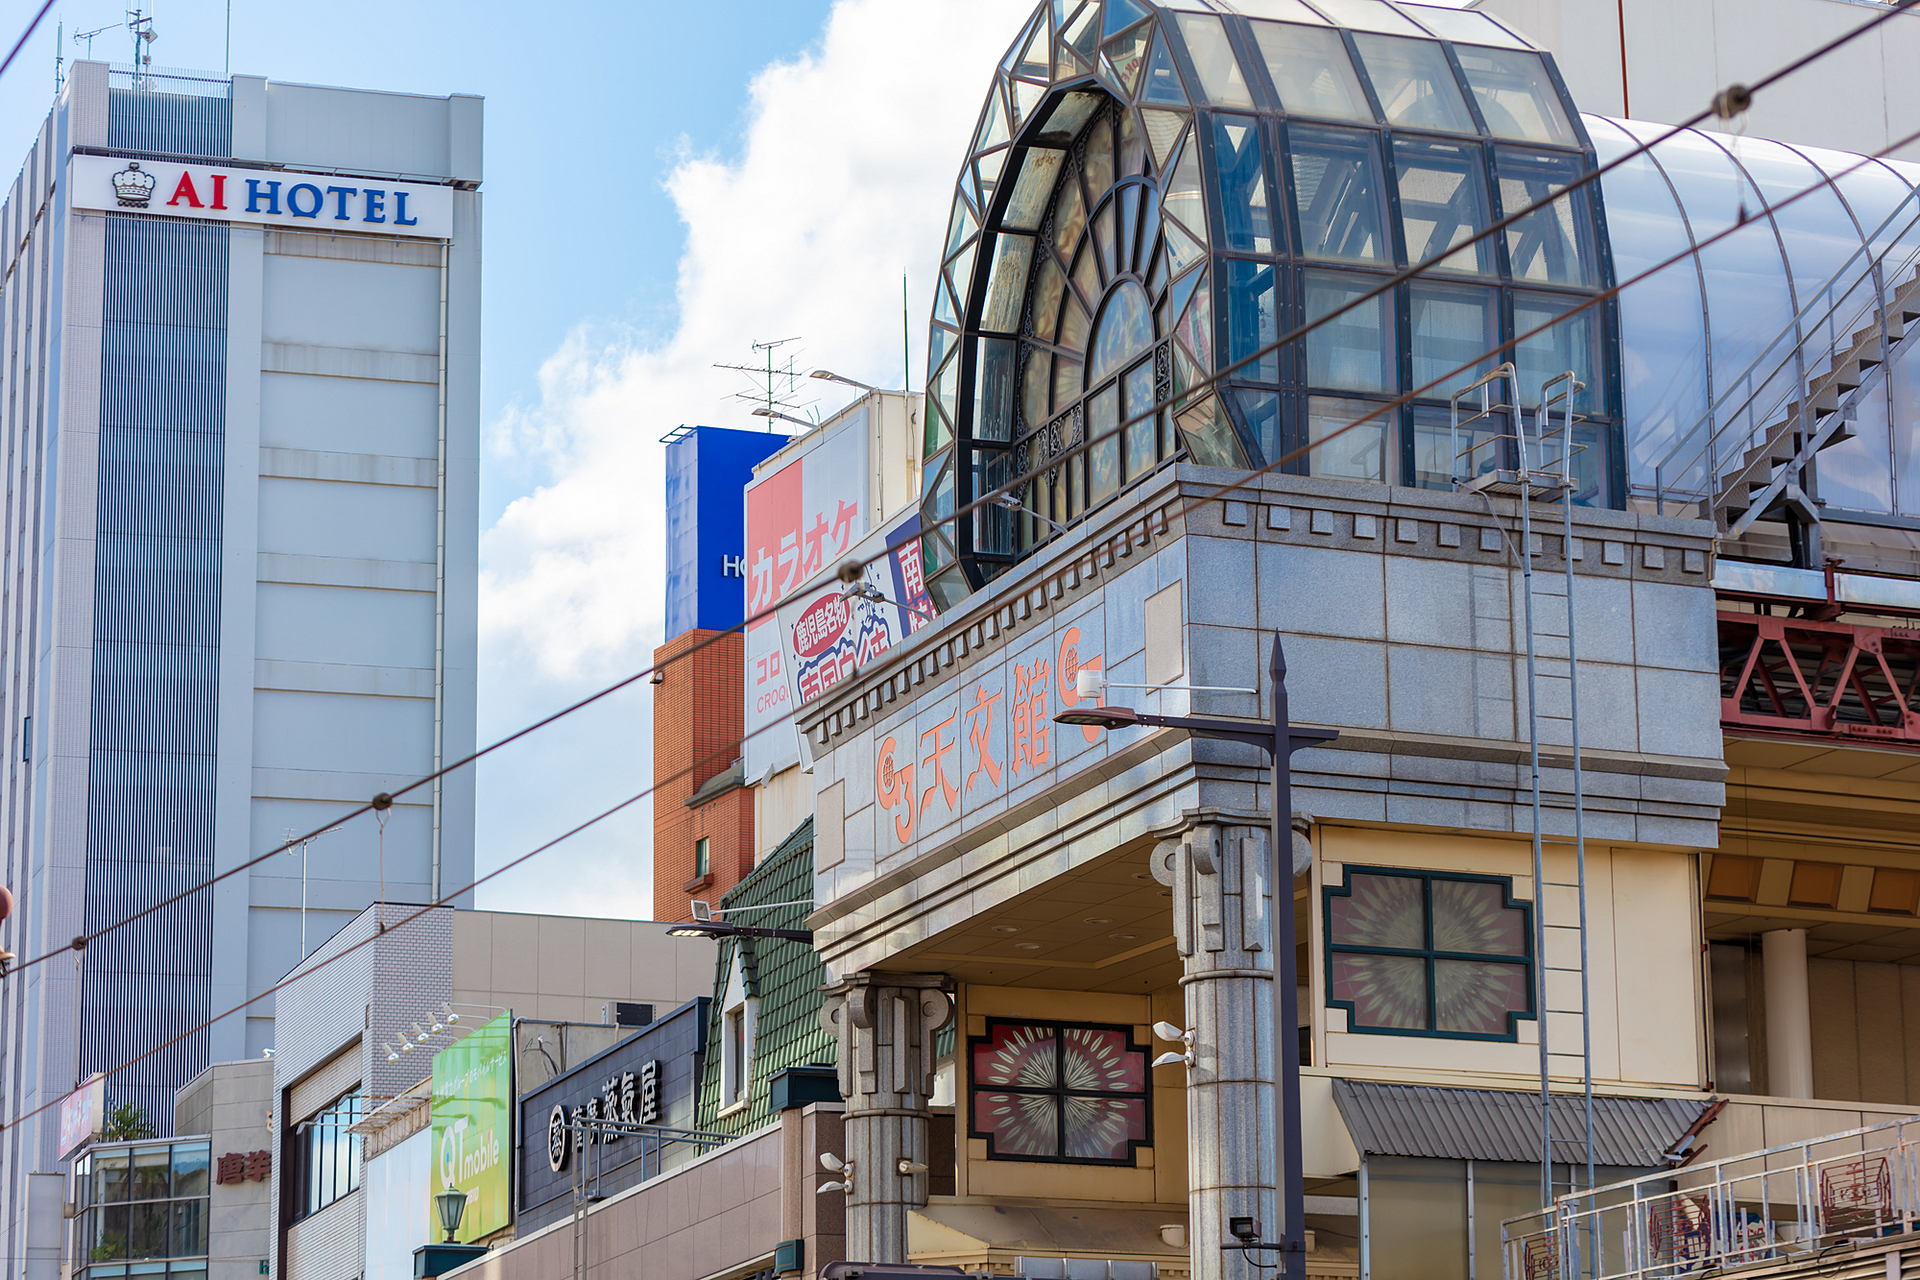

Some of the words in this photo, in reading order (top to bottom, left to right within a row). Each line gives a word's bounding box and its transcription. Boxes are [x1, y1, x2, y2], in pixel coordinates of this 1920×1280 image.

[166, 170, 228, 210] AI
[245, 178, 418, 226] HOTEL
[723, 554, 745, 578] H
[750, 499, 858, 617] カラオケ
[796, 594, 847, 655] 鹿児島名物
[919, 657, 1051, 827] 天文館
[216, 1150, 272, 1185] 唐芋
